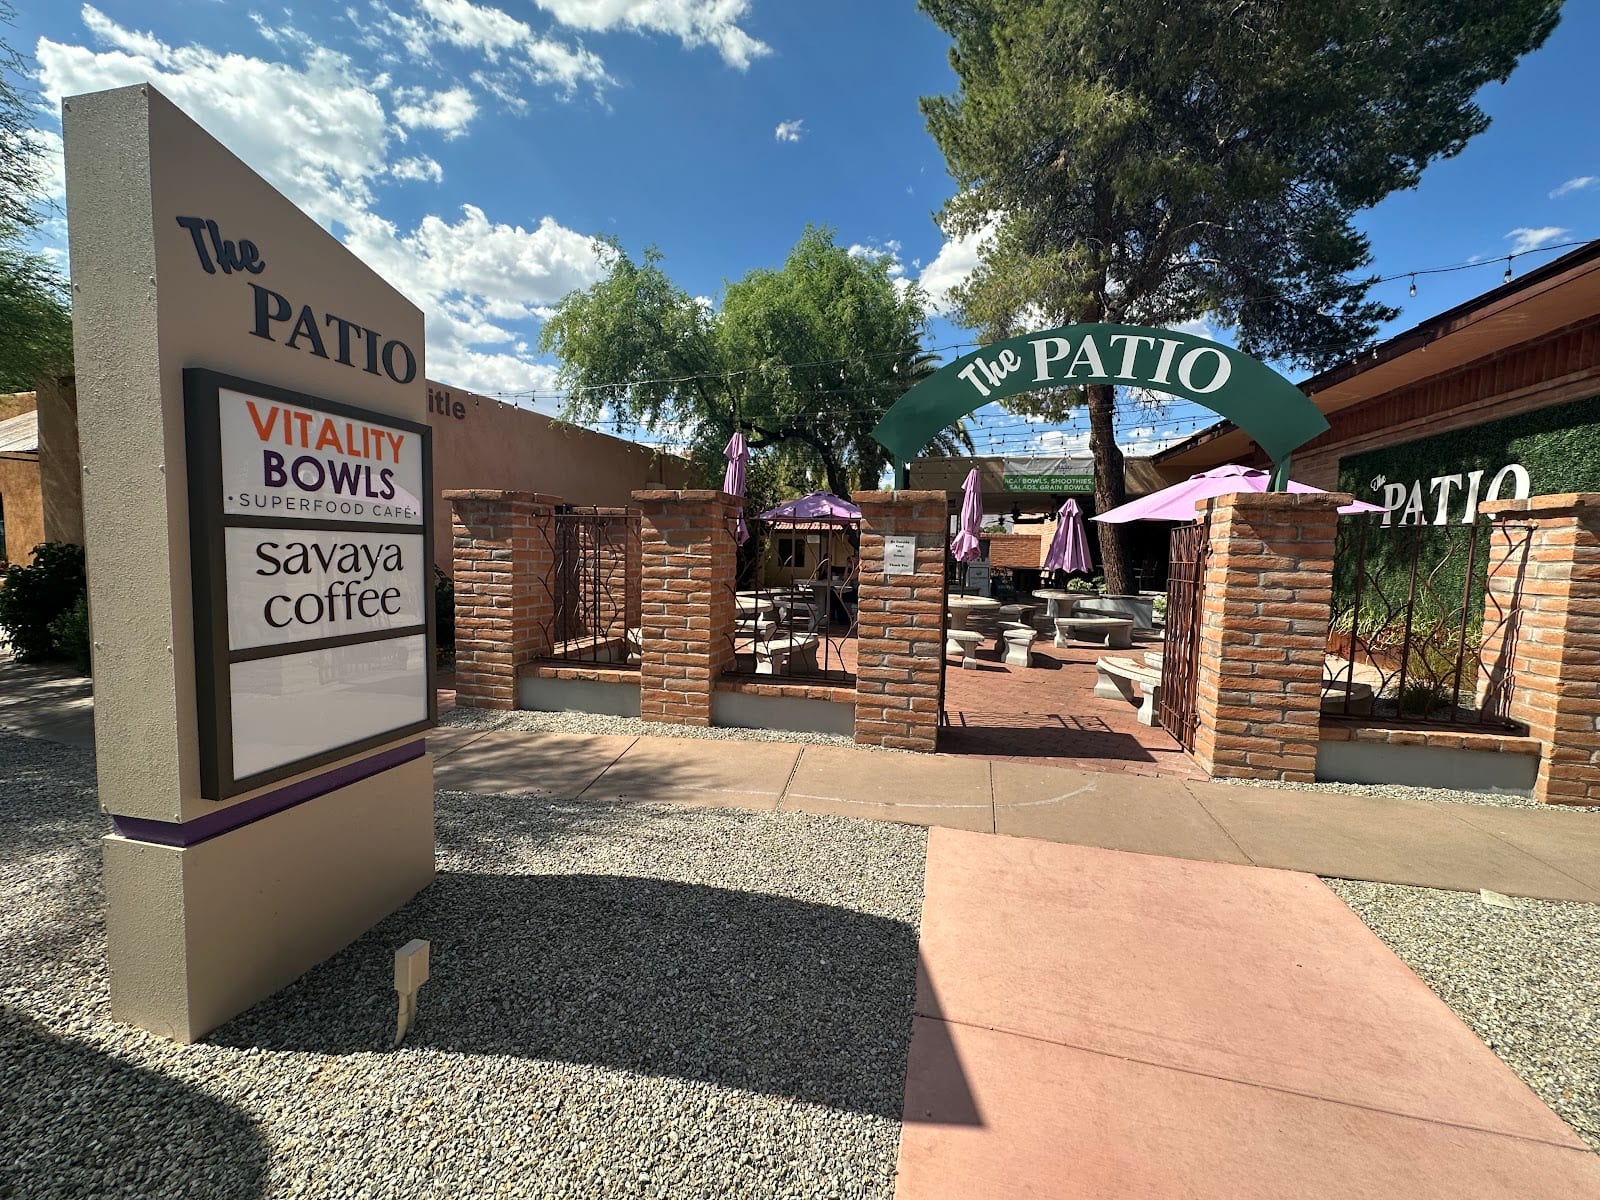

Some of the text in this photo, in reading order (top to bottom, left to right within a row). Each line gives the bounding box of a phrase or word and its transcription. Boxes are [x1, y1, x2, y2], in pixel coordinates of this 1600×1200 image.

[175, 216, 266, 275] The
[247, 281, 417, 385] PATIO
[957, 334, 1232, 397] The PATIO
[428, 388, 466, 420] itle
[246, 401, 404, 464] VITALITY
[263, 449, 395, 500] BOWLS
[1379, 464, 1531, 529] PATIO
[239, 493, 412, 519] SUPERFOOD CAFÉ
[255, 542, 404, 581] savaya
[263, 580, 401, 628] coffee
